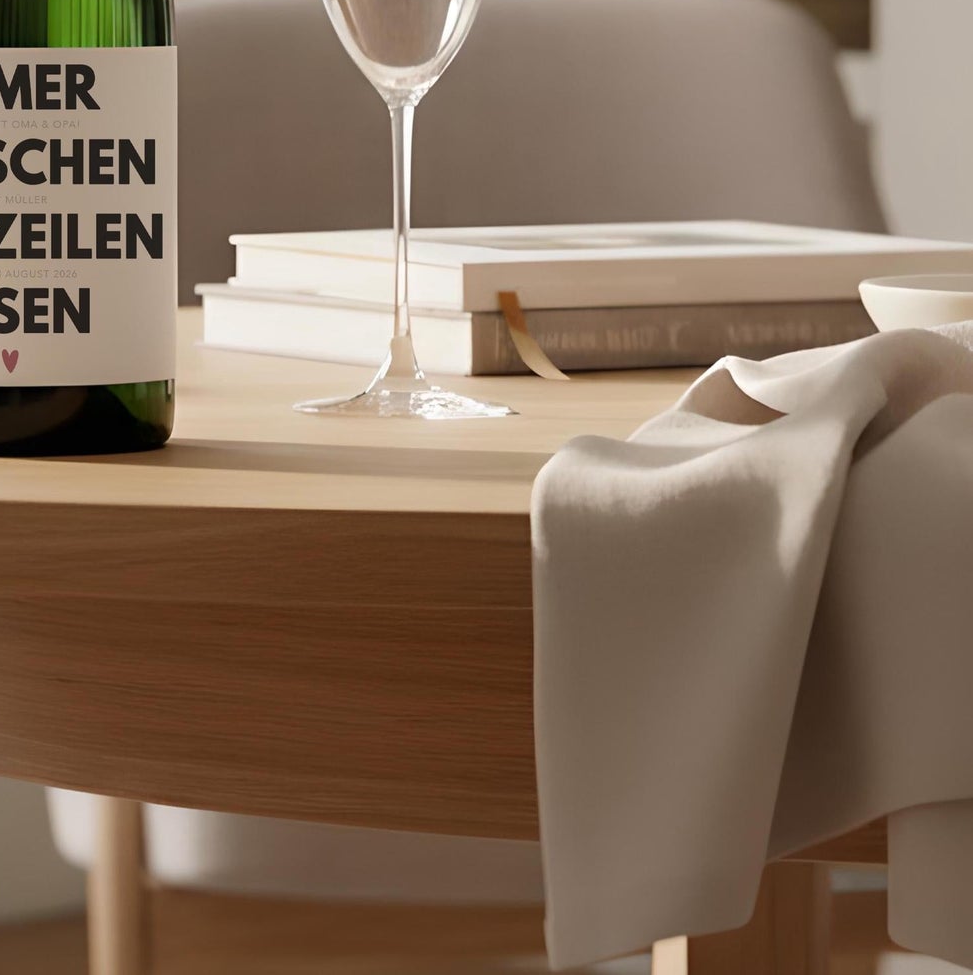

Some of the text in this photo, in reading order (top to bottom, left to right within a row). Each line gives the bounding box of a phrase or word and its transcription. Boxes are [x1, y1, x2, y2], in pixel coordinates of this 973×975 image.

[11, 120, 38, 129] OMA
[41, 120, 50, 129] &
[52, 119, 80, 129] OPA!
[5, 193, 48, 204] MÜLLER
[4, 269, 51, 279] AUGUST
[53, 269, 78, 279] 2026
